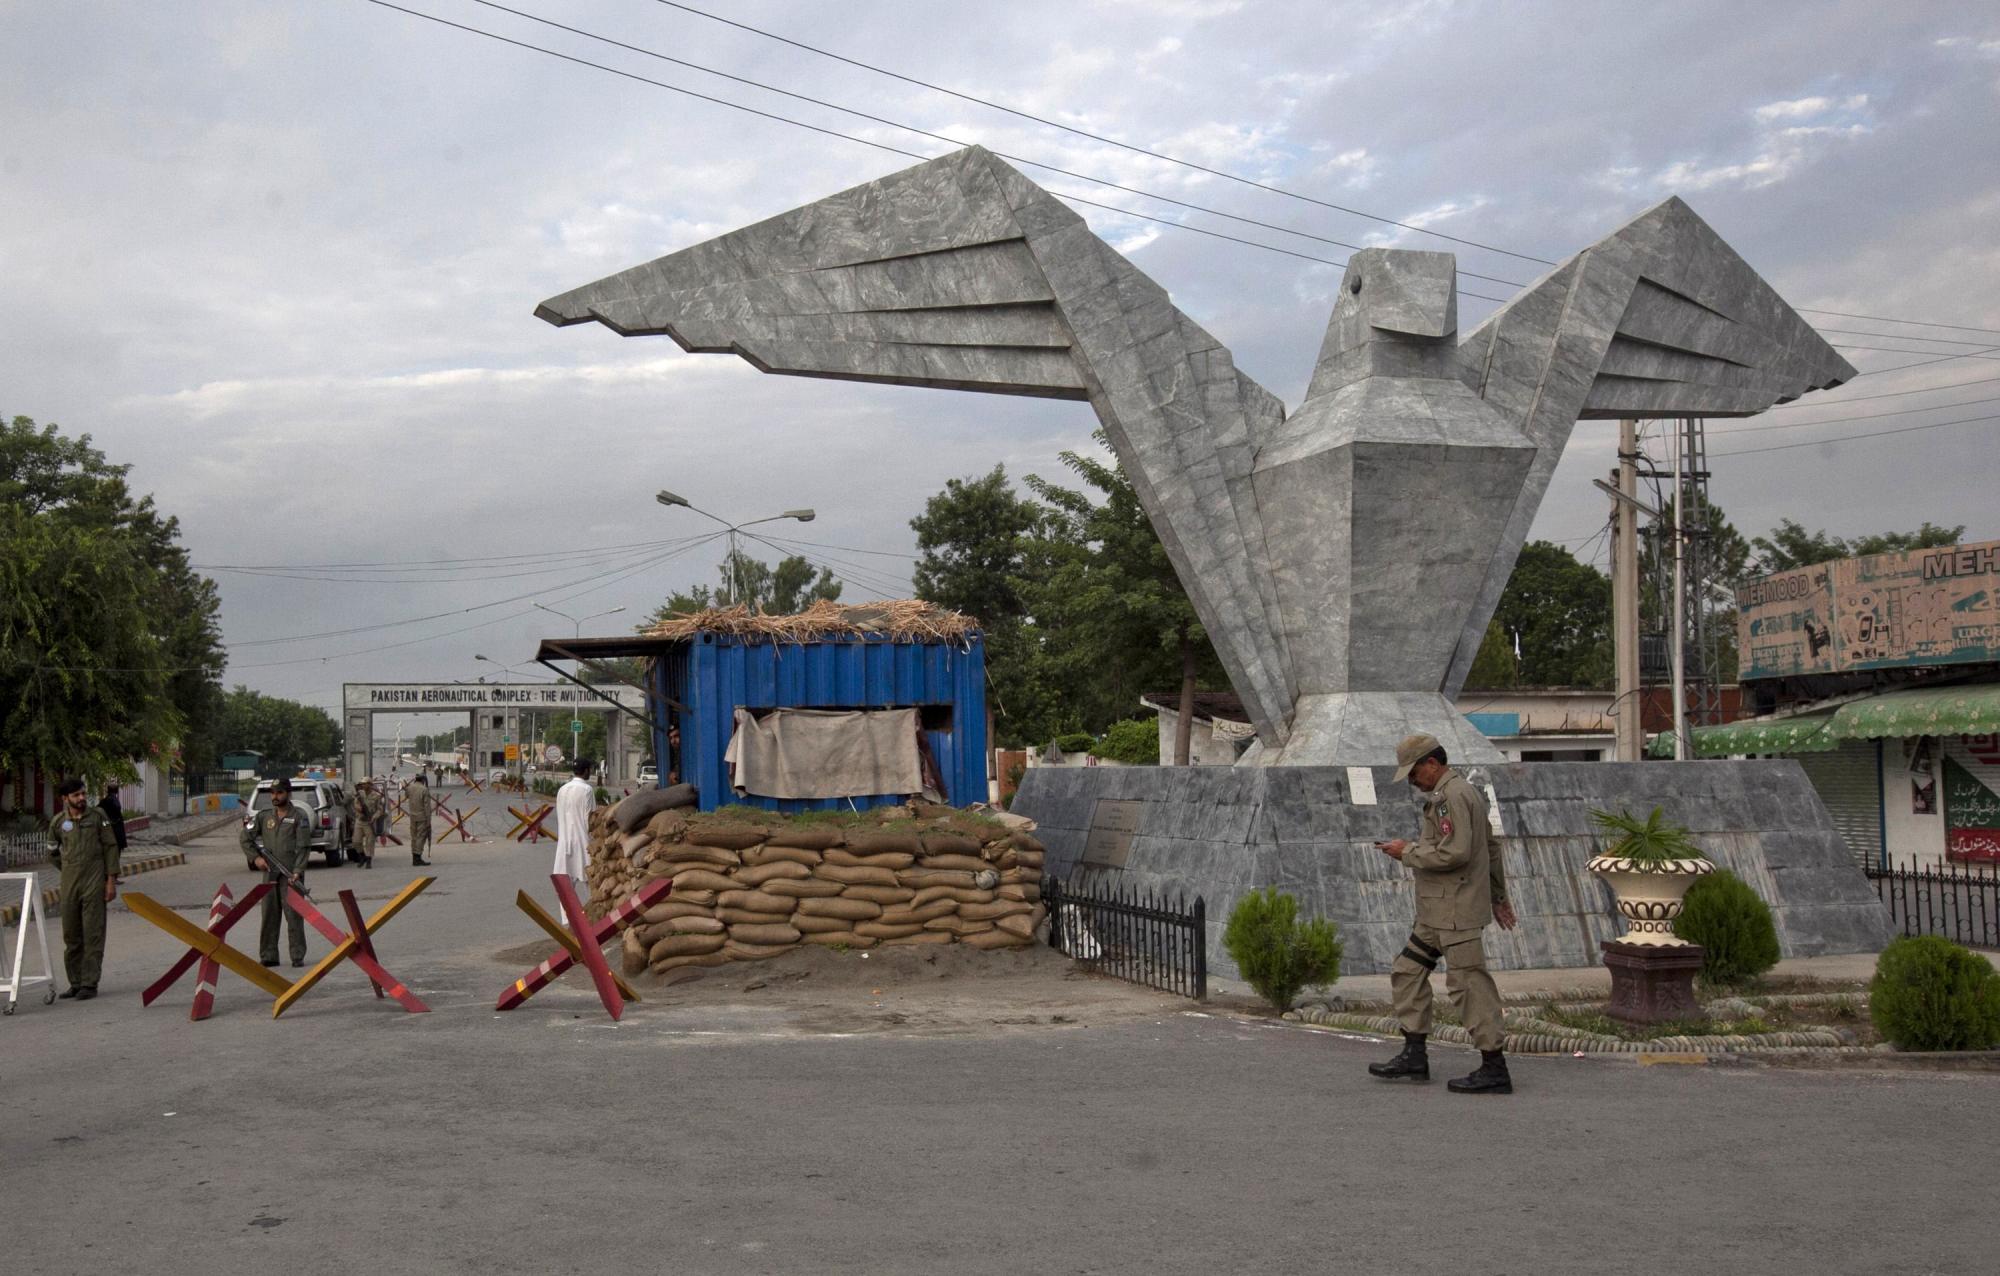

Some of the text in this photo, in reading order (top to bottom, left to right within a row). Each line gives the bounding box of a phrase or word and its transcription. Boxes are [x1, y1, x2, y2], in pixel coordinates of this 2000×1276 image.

[1924, 547, 2000, 580] MEH
[1739, 574, 1810, 608] MEHMOOD
[371, 690, 418, 702] PAKISTAN
[421, 690, 487, 702] AERONAUTICAL
[491, 690, 531, 702] COMPLEX
[541, 690, 556, 702] THE
